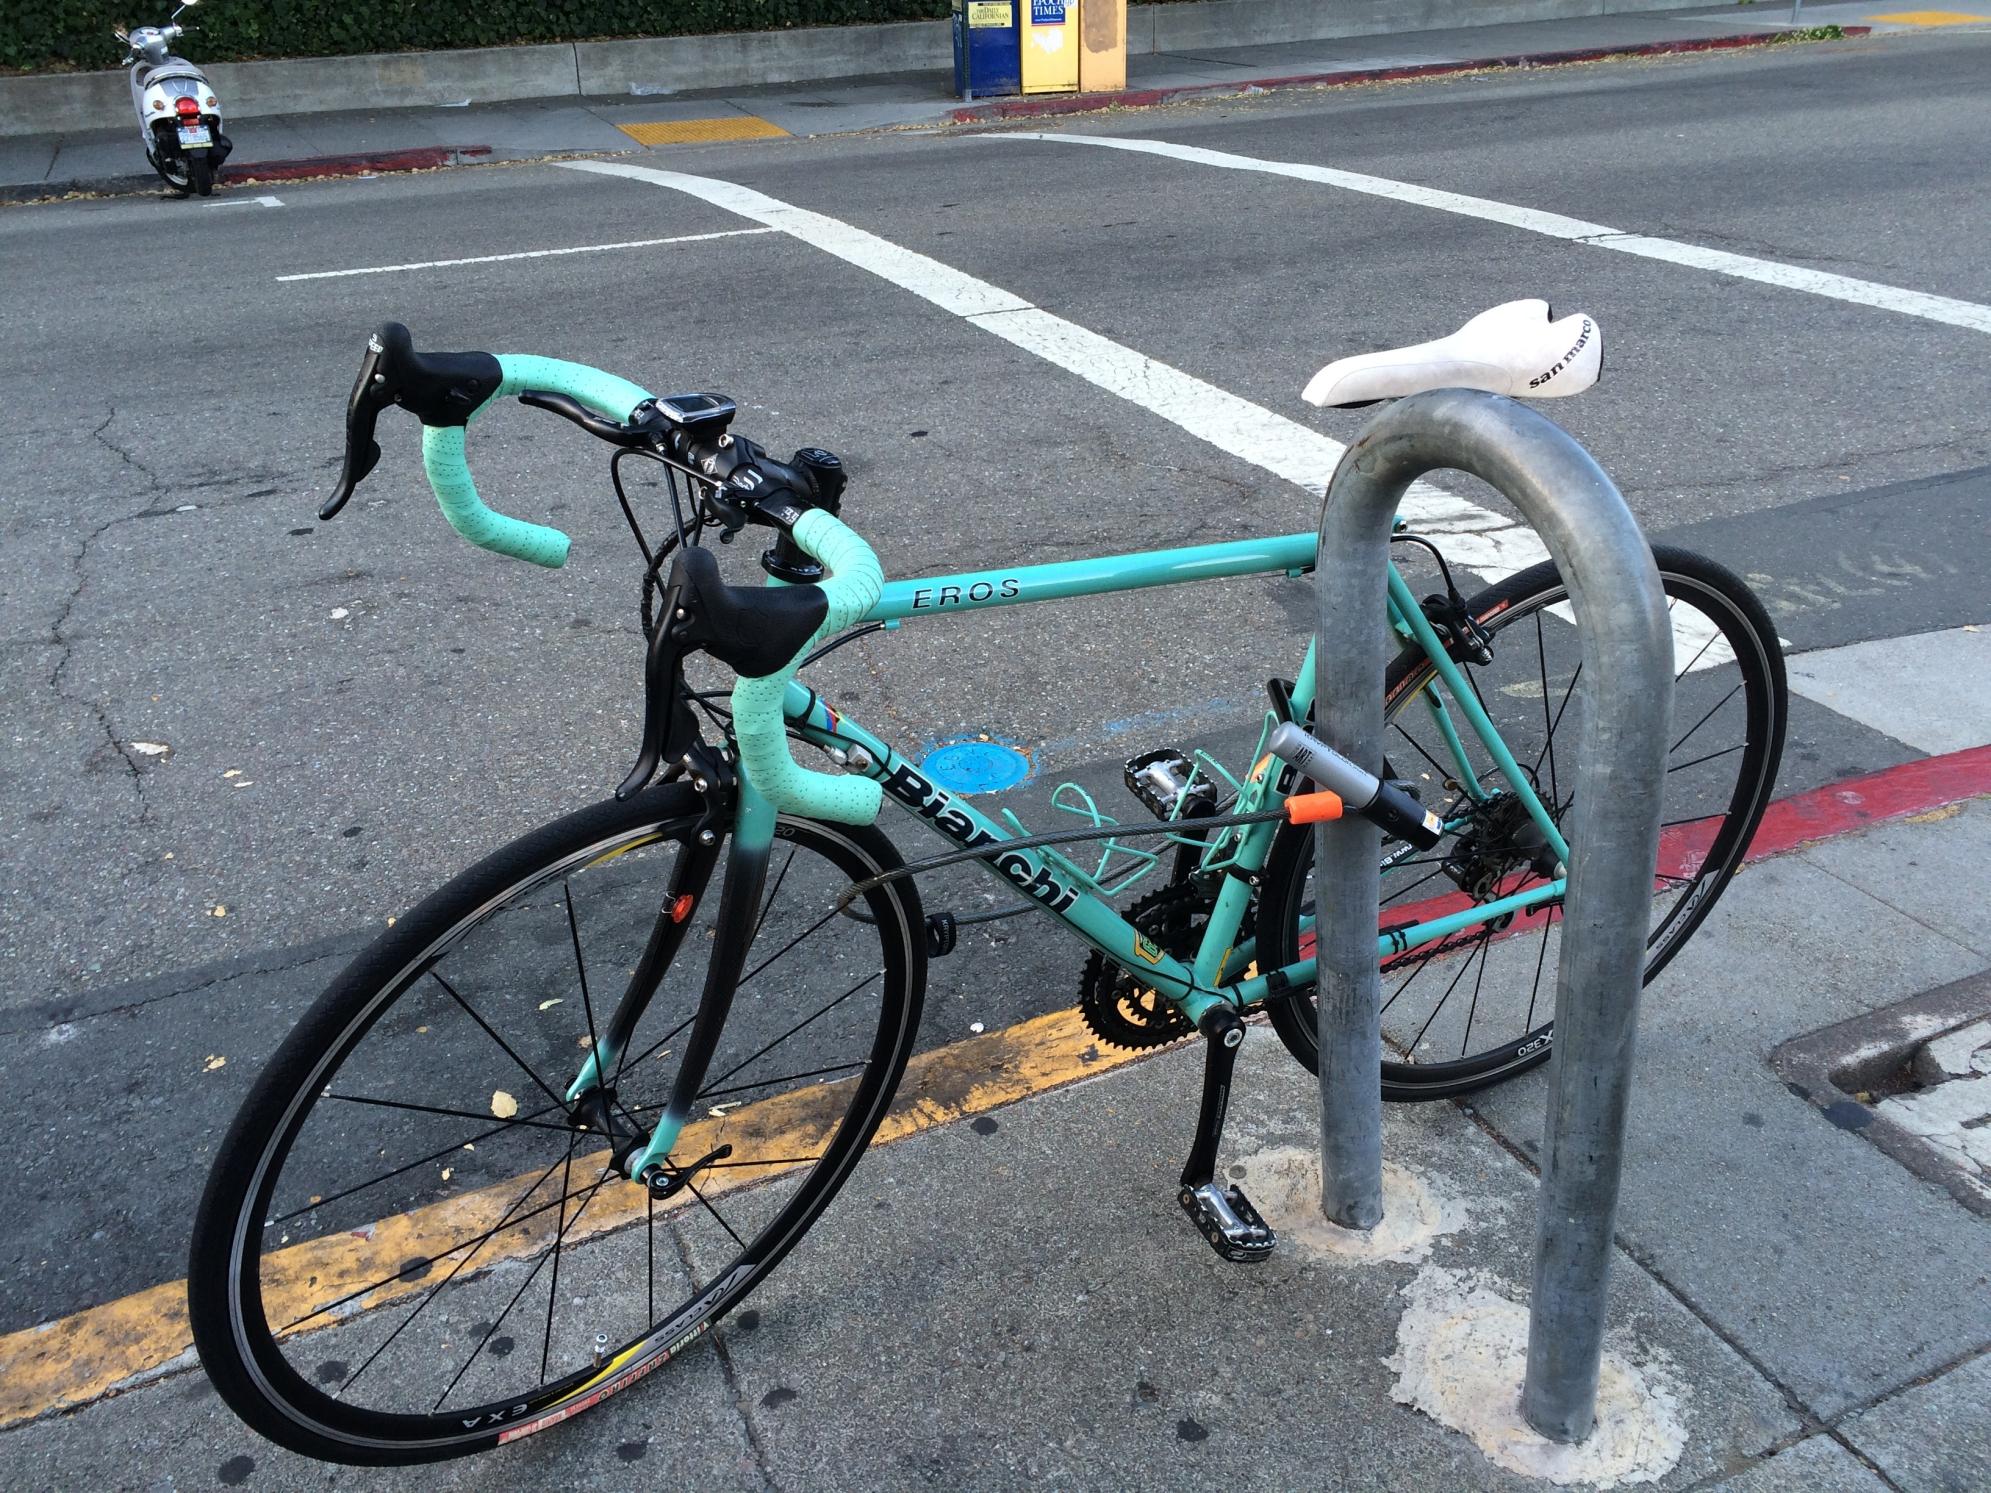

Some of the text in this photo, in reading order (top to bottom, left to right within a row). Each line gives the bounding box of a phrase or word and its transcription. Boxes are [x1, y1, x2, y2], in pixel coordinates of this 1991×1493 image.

[1033, 6, 1064, 15] TIMES
[1529, 319, 1592, 389] san marco
[913, 579, 1019, 608] EROS
